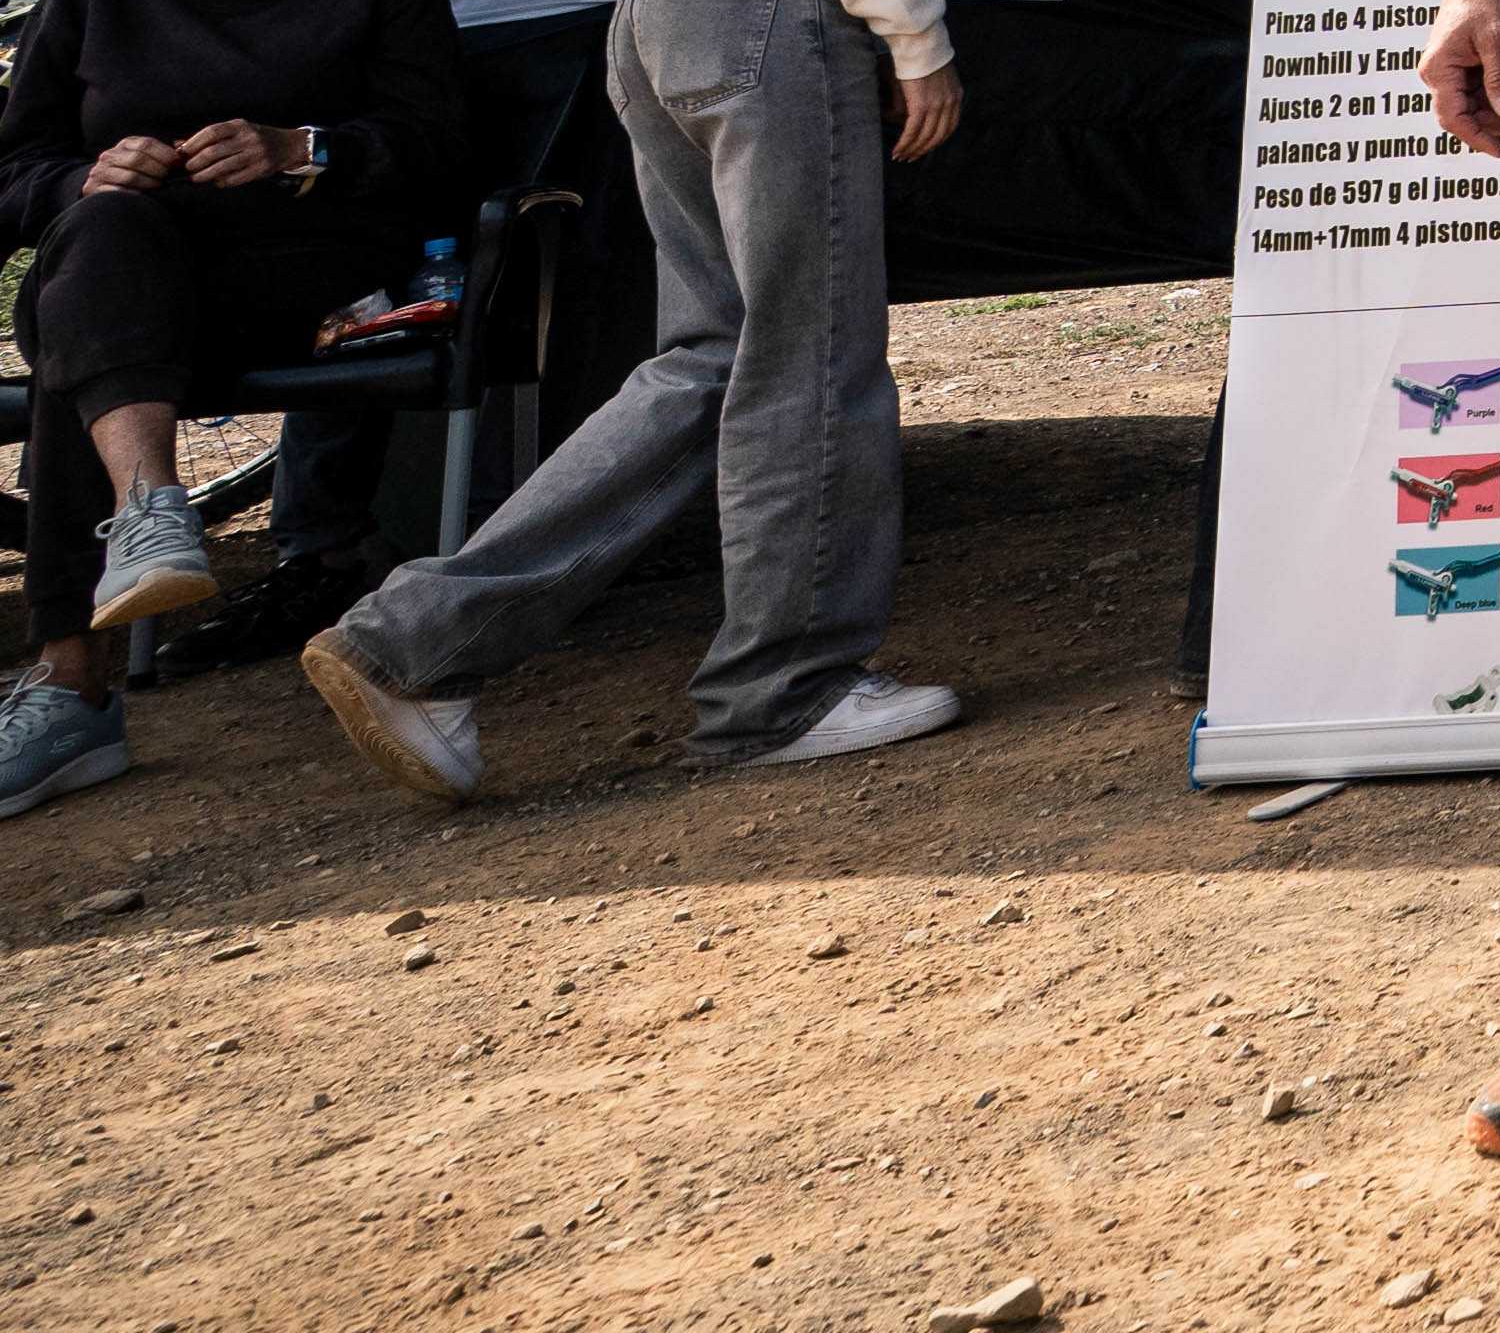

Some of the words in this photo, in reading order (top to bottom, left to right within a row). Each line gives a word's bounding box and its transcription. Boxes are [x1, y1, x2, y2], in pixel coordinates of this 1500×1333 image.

[1265, 10, 1316, 36] Pinza
[1321, 7, 1348, 32] de
[1353, 6, 1367, 30] 4
[1263, 51, 1352, 79] Downhill
[1357, 51, 1370, 76] y
[1259, 95, 1324, 124] Ajuste
[1329, 94, 1342, 118] 2
[1348, 92, 1375, 117] en
[1383, 91, 1391, 115] 1
[1256, 141, 1341, 168] palanca
[1346, 139, 1360, 163] y
[1364, 135, 1429, 162] punto
[1434, 132, 1462, 156] de
[1254, 185, 1303, 210] Peso
[1309, 182, 1337, 207] de
[1342, 179, 1383, 205] 597
[1388, 181, 1401, 205] g
[1407, 176, 1428, 201] el
[1252, 225, 1391, 254] 14mm+17mm
[1396, 221, 1410, 246] 4
[1467, 409, 1496, 419] Purple
[1475, 504, 1494, 513] Red
[1455, 600, 1477, 610] Deep
[1478, 599, 1497, 608] blue
